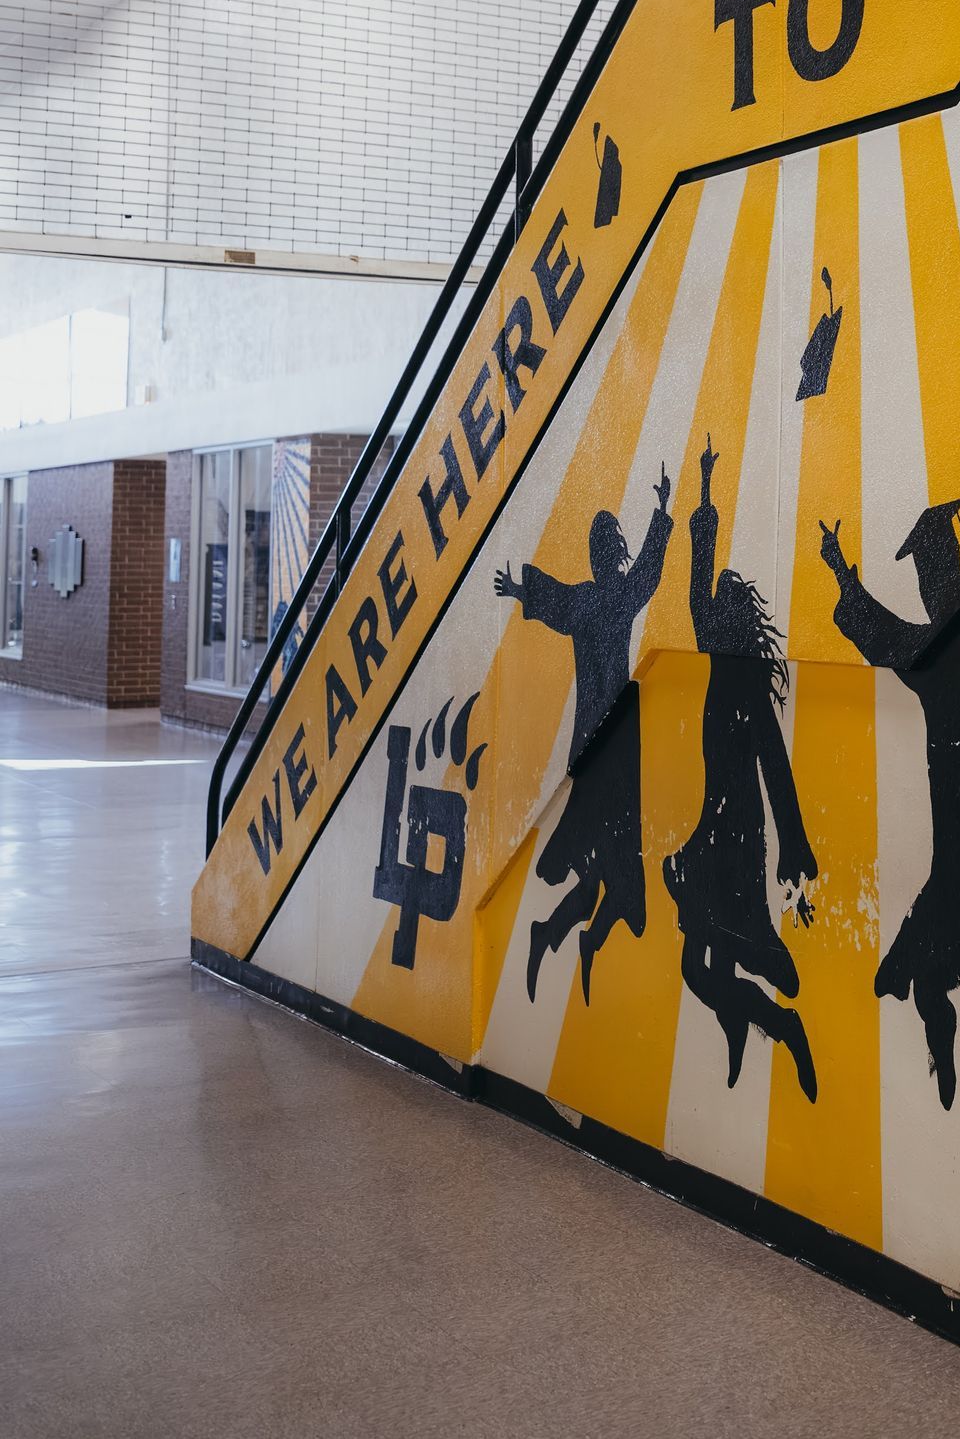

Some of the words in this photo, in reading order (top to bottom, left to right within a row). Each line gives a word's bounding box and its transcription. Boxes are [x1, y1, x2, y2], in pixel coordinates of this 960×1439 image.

[246, 722, 318, 876] WE
[323, 530, 418, 759] ARE
[417, 224, 585, 560] HERE
